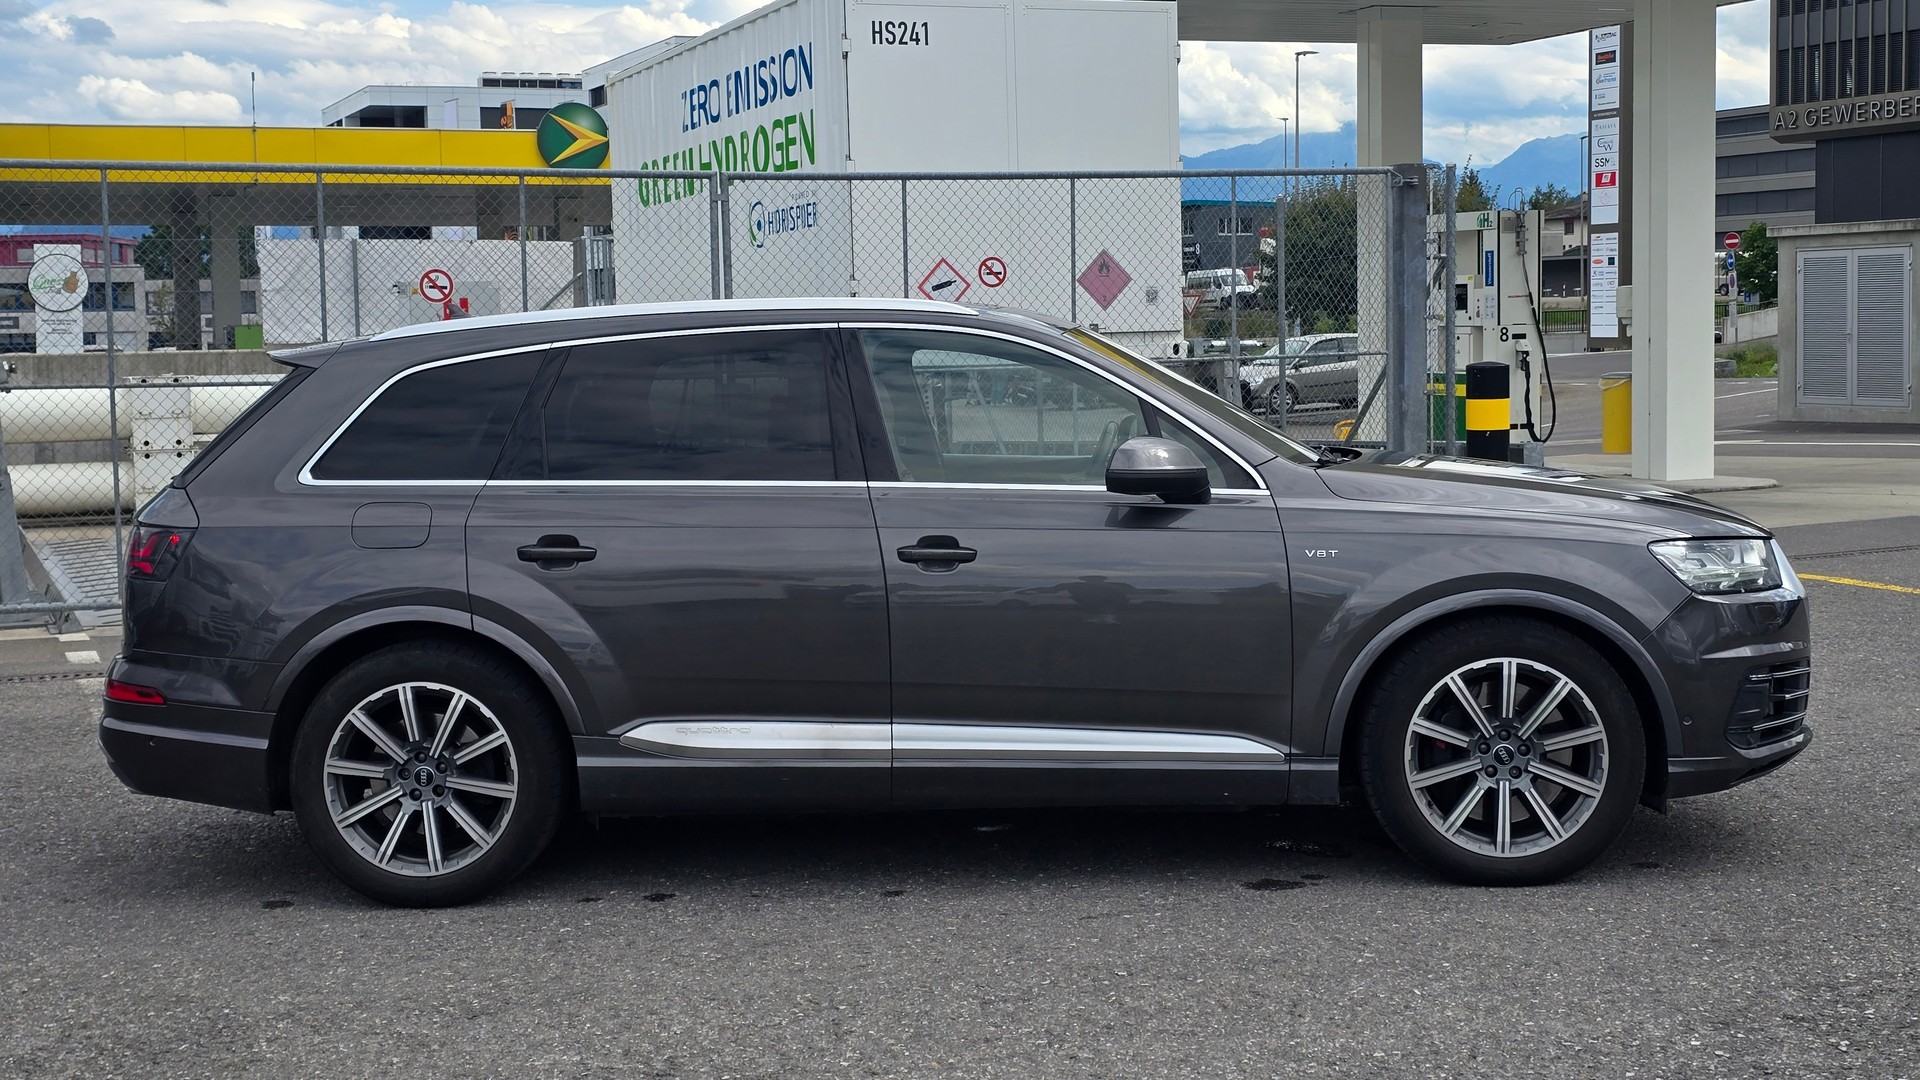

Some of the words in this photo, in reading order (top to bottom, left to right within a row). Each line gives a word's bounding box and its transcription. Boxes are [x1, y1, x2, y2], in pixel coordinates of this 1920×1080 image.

[871, 20, 929, 46] HS241
[681, 78, 721, 134] ZERO
[725, 41, 813, 118] EMISSION
[1774, 110, 1798, 130] A2
[637, 147, 695, 209] GREEN
[698, 108, 815, 194] HYDROGEN
[1500, 327, 1509, 342] 8
[676, 726, 751, 736] quattro
